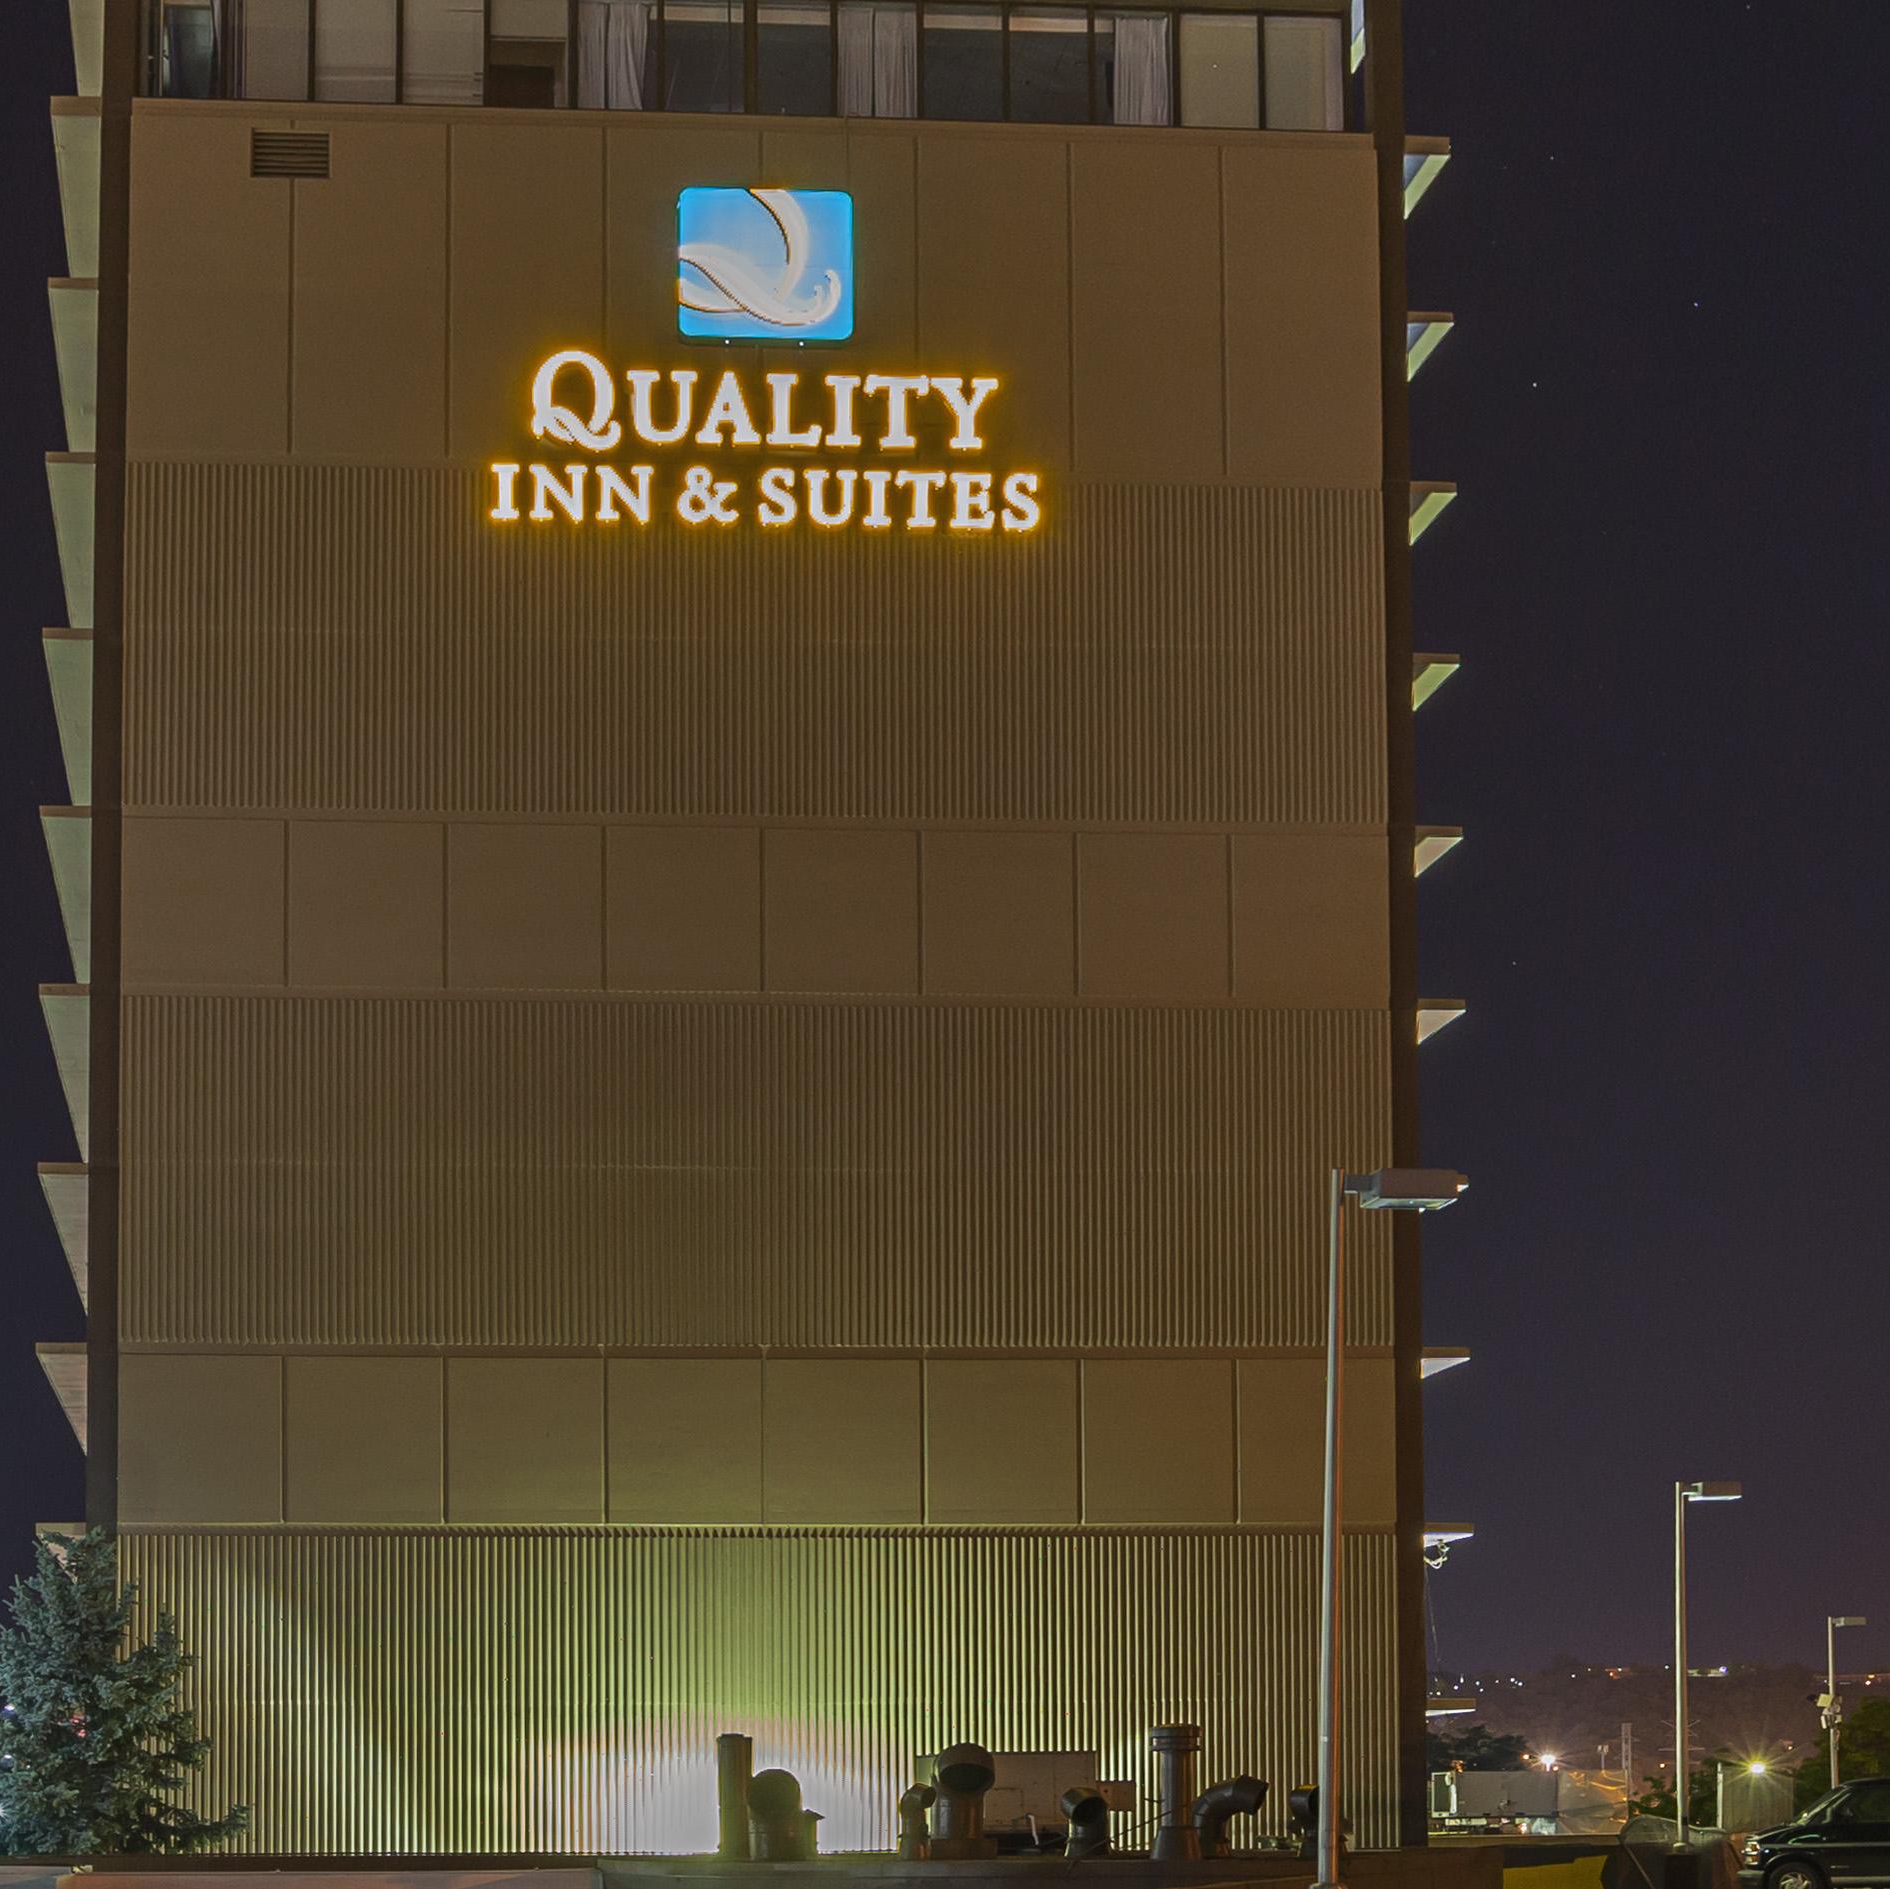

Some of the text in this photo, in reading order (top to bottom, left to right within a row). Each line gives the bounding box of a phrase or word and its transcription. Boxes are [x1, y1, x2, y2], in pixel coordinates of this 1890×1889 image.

[532, 350, 999, 450] QUALITY
[491, 463, 1041, 531] INN & SUITES
